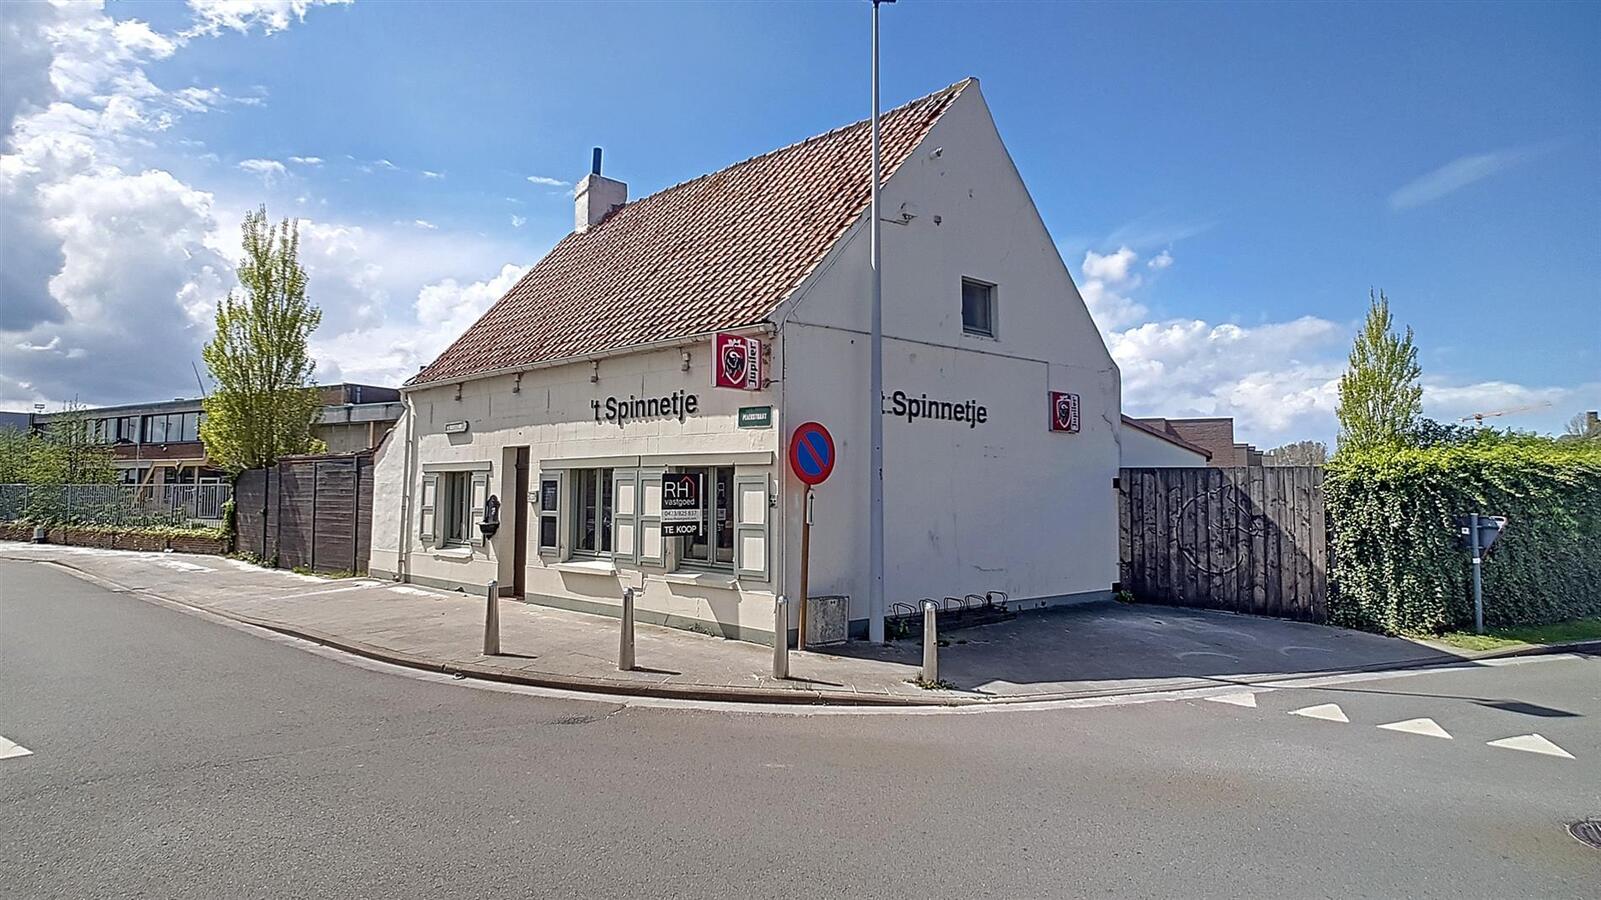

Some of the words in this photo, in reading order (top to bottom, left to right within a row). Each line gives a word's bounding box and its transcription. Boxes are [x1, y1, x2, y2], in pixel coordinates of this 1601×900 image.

[748, 341, 758, 387] Jupiler
[591, 400, 600, 421] 't
[605, 389, 697, 425] Spinnetje
[892, 391, 987, 429] Spinnetje
[664, 481, 688, 498] RH
[664, 498, 695, 507] vastgoed
[664, 525, 674, 534] TE
[676, 525, 697, 533] KOOP
